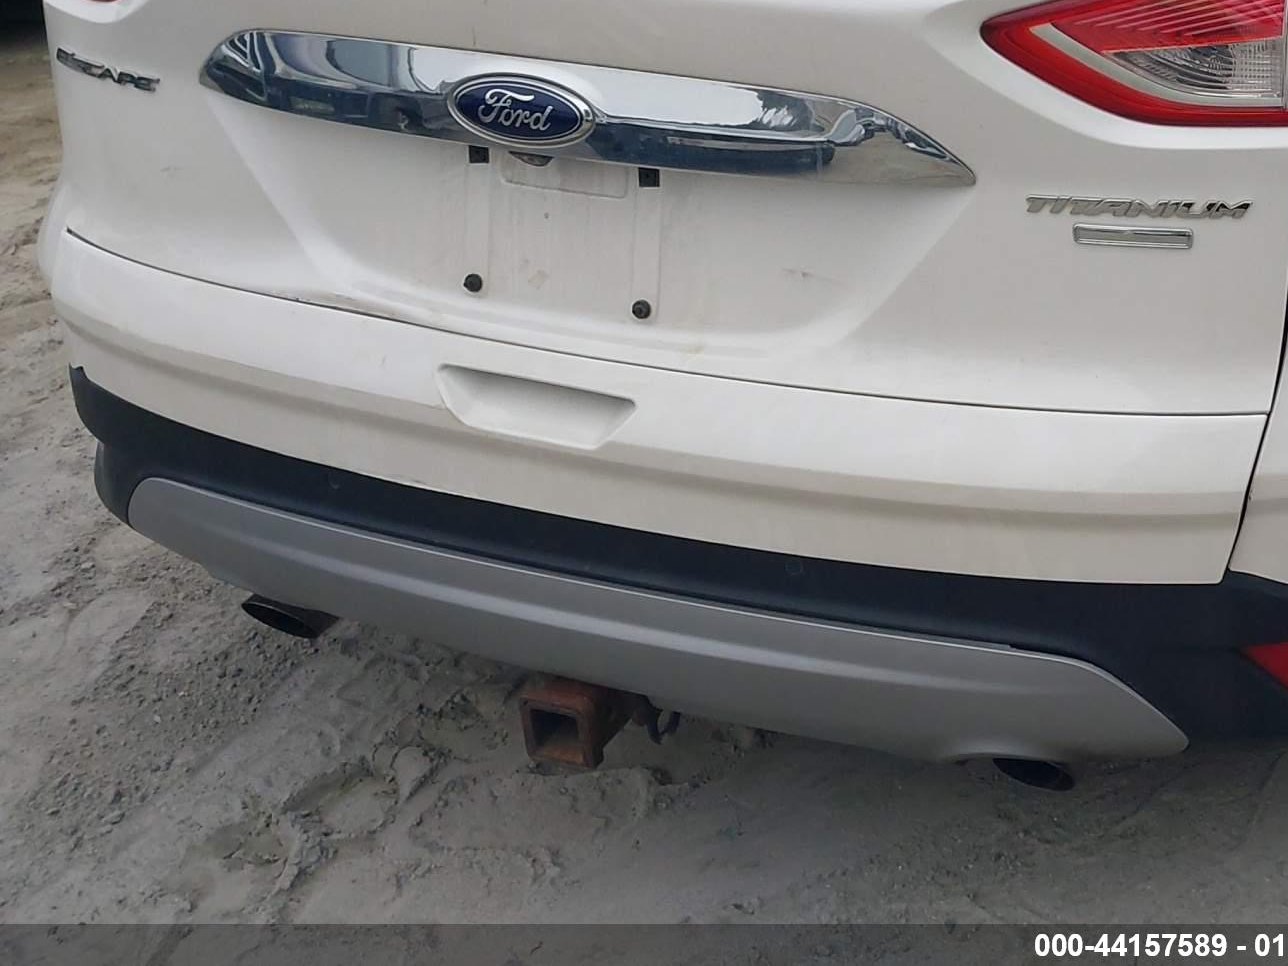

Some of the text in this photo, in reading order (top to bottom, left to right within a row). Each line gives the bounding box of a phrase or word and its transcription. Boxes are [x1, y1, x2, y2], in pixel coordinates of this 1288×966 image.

[55, 46, 161, 94] ESCAPE
[477, 88, 553, 131] Ford
[1025, 194, 1253, 220] TITANIUM
